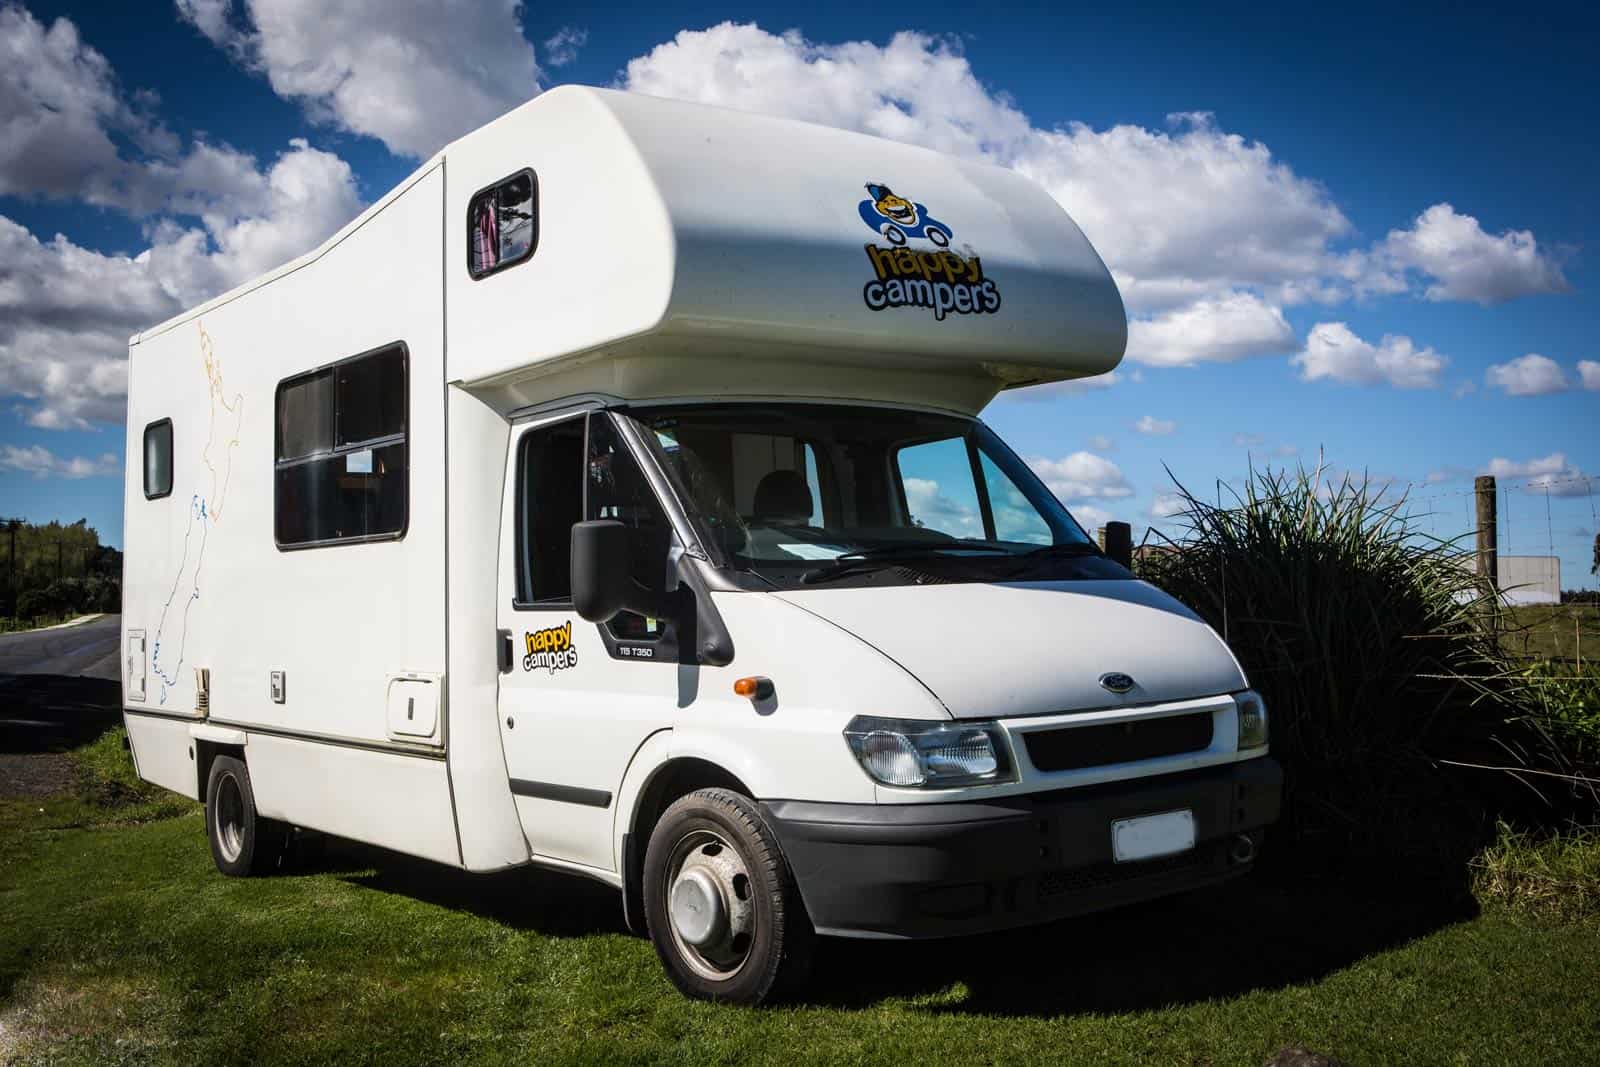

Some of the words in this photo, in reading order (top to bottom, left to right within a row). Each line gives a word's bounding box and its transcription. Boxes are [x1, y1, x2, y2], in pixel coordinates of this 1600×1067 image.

[865, 245, 982, 283] happy
[864, 278, 1001, 321] campers
[525, 620, 572, 653] happy
[631, 647, 653, 657] T350
[523, 646, 577, 674] campers
